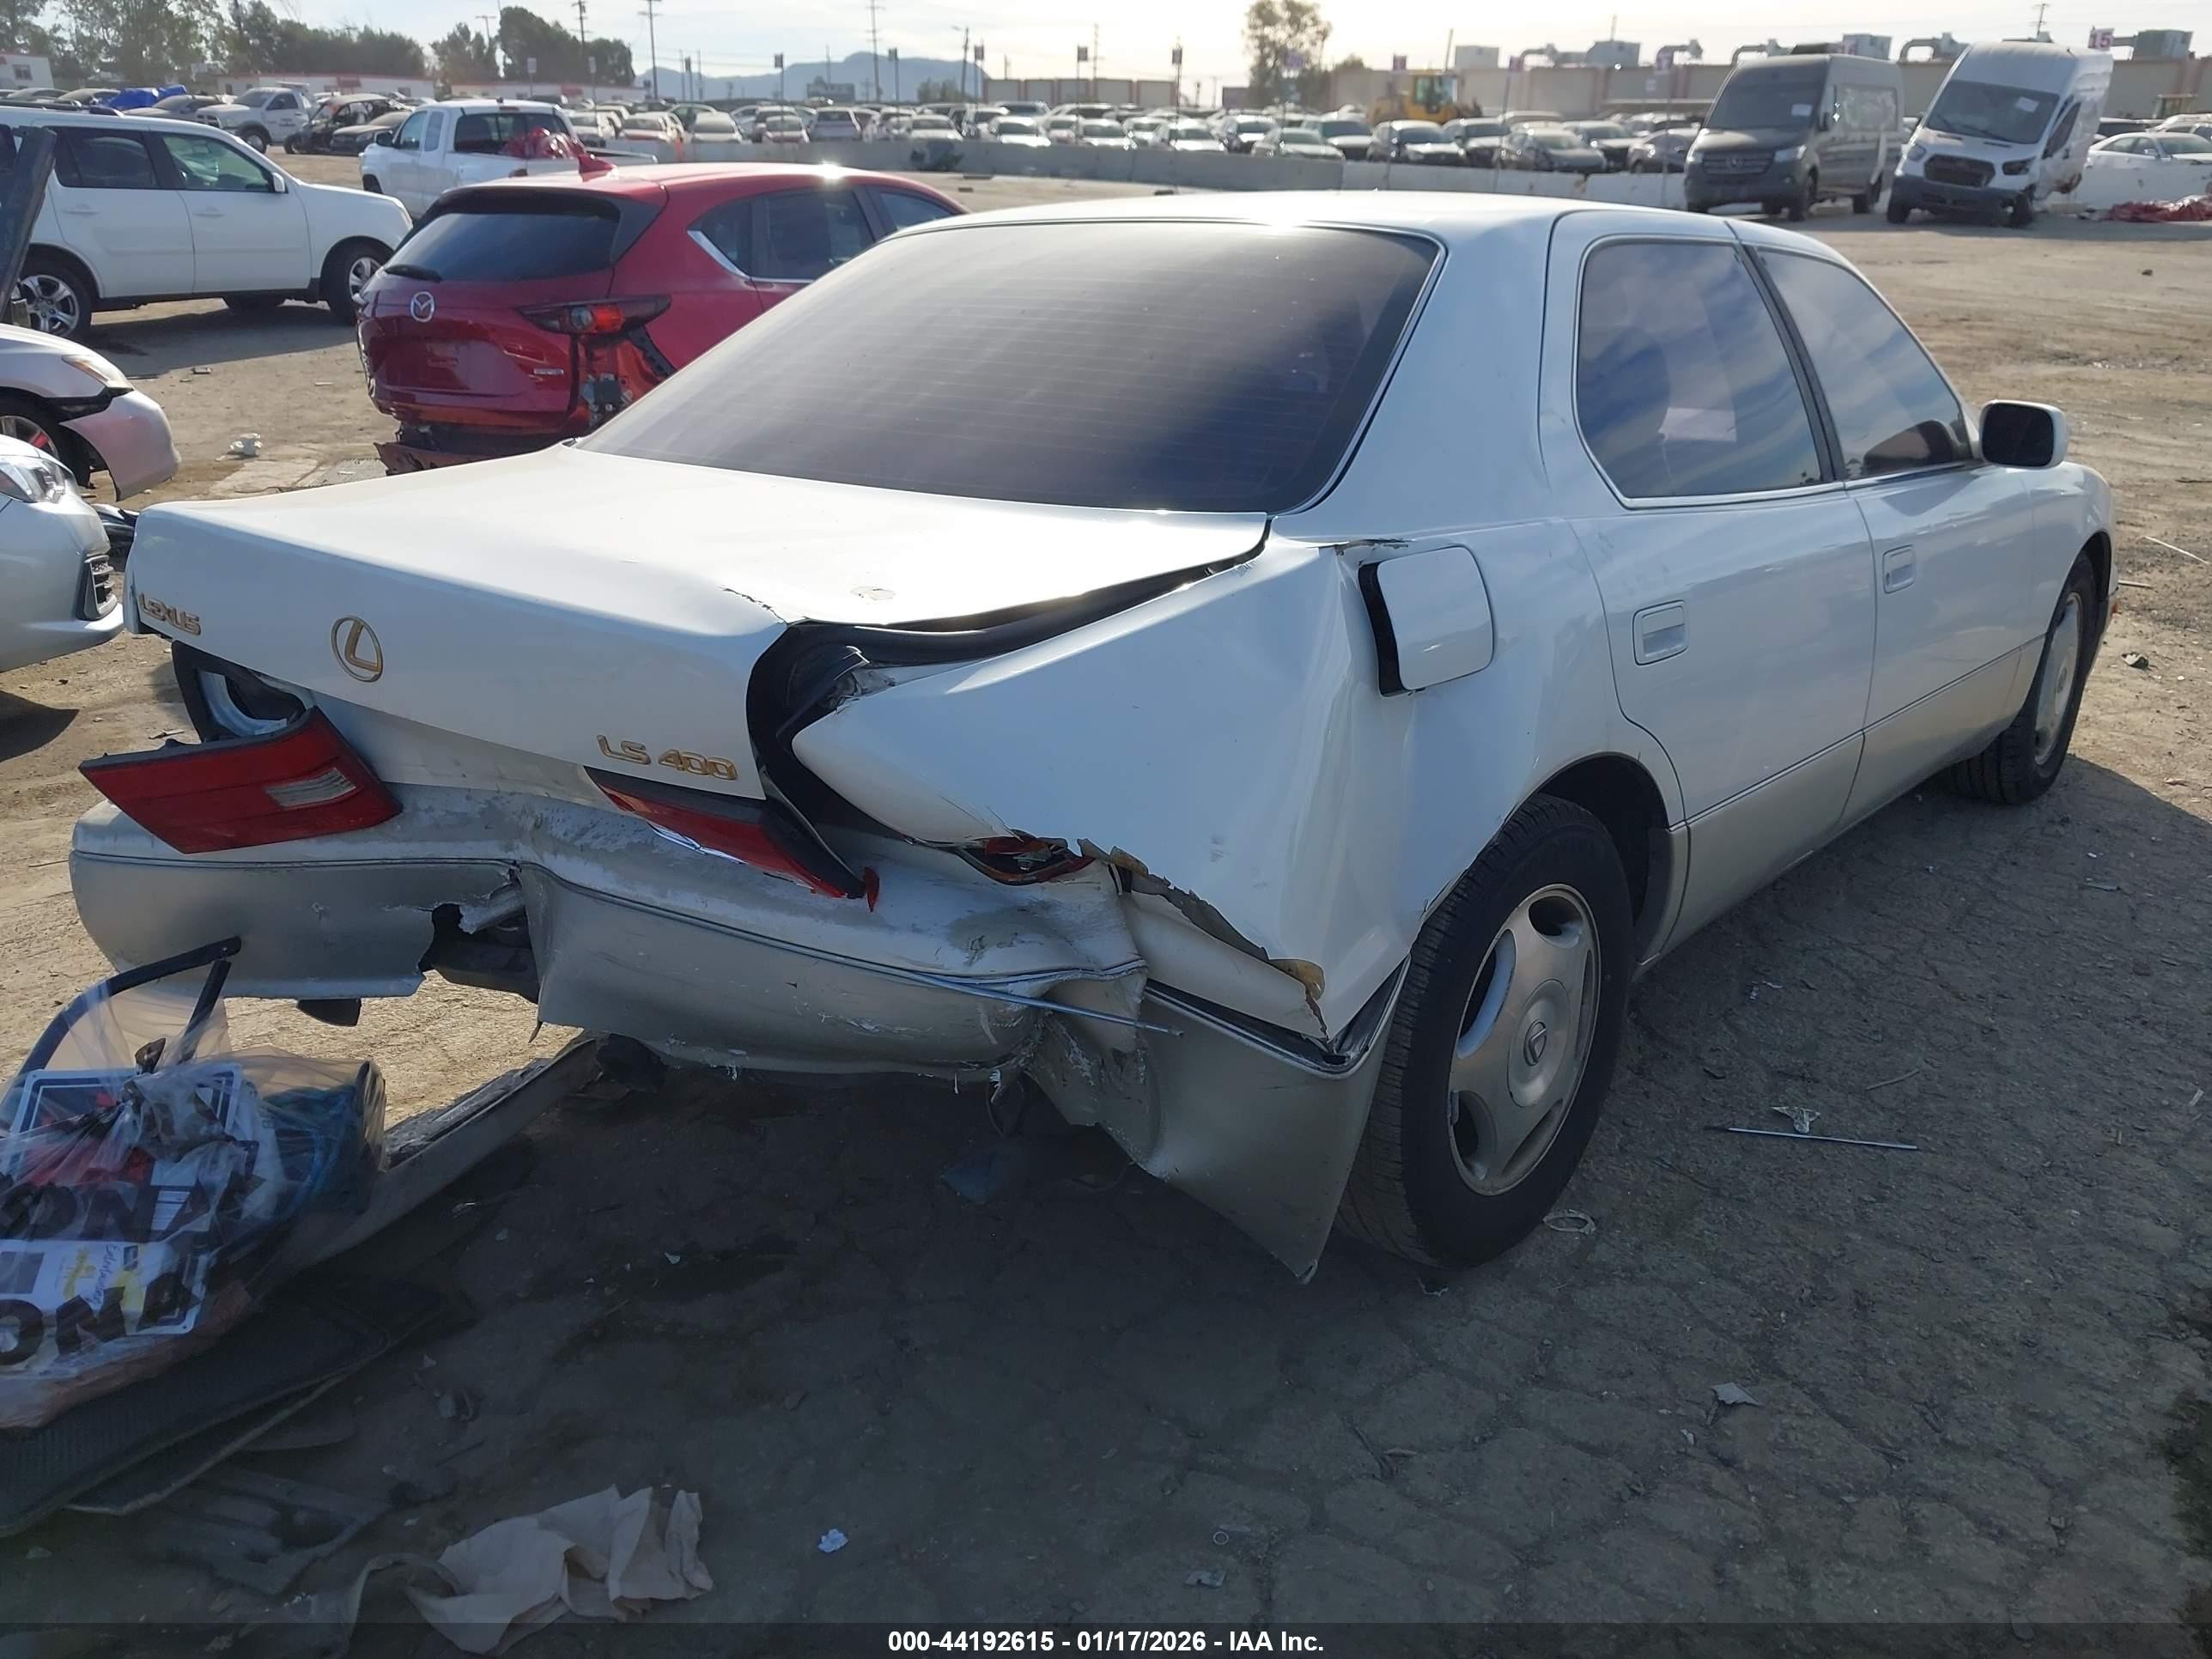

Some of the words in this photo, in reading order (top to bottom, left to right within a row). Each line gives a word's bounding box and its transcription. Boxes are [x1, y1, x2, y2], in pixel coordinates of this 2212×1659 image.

[138, 592, 202, 636] LEXUS
[596, 734, 652, 765] LS
[658, 749, 738, 781] 400
